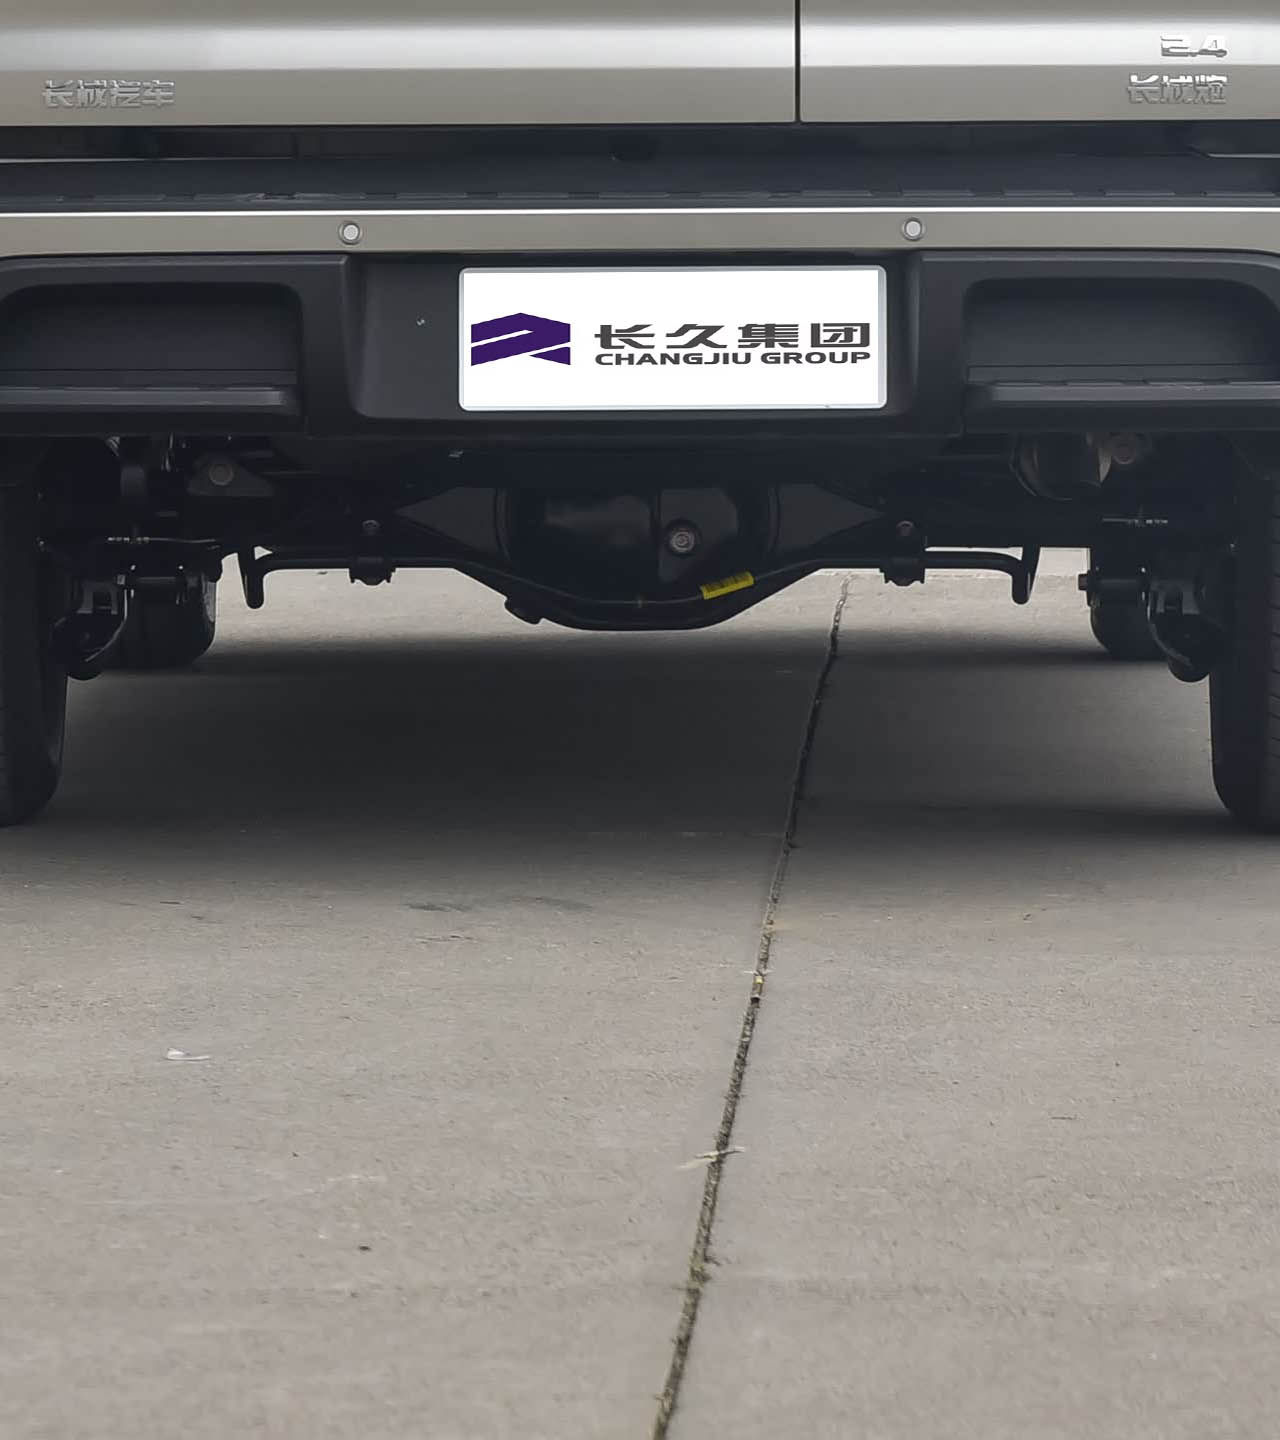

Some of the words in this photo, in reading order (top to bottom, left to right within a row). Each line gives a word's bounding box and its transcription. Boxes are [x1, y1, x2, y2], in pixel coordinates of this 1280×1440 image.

[42, 79, 175, 108] 长城汽车
[1128, 74, 1229, 104] 长城炮
[594, 322, 871, 349] 长久集团
[595, 351, 752, 365] CHANGJIU
[760, 351, 871, 365] GROUP
